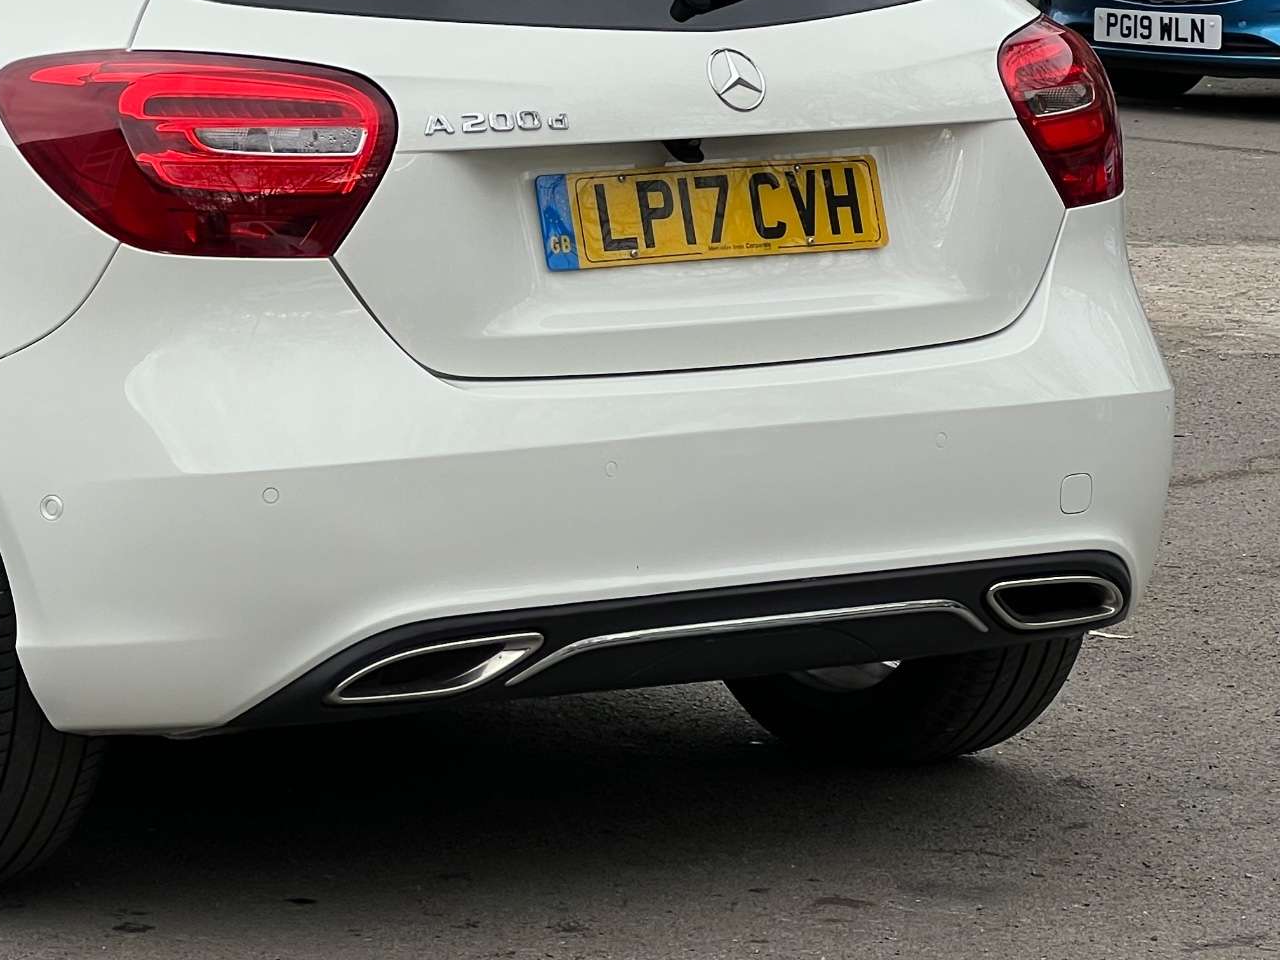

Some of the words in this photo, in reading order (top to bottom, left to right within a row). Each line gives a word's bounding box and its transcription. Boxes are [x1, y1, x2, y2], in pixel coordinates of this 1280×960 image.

[1106, 12, 1153, 40] PG19
[1159, 16, 1205, 43] WLN
[424, 113, 455, 136] A
[593, 174, 729, 252] LP17
[749, 167, 864, 240] CVH
[550, 234, 571, 254] GB
